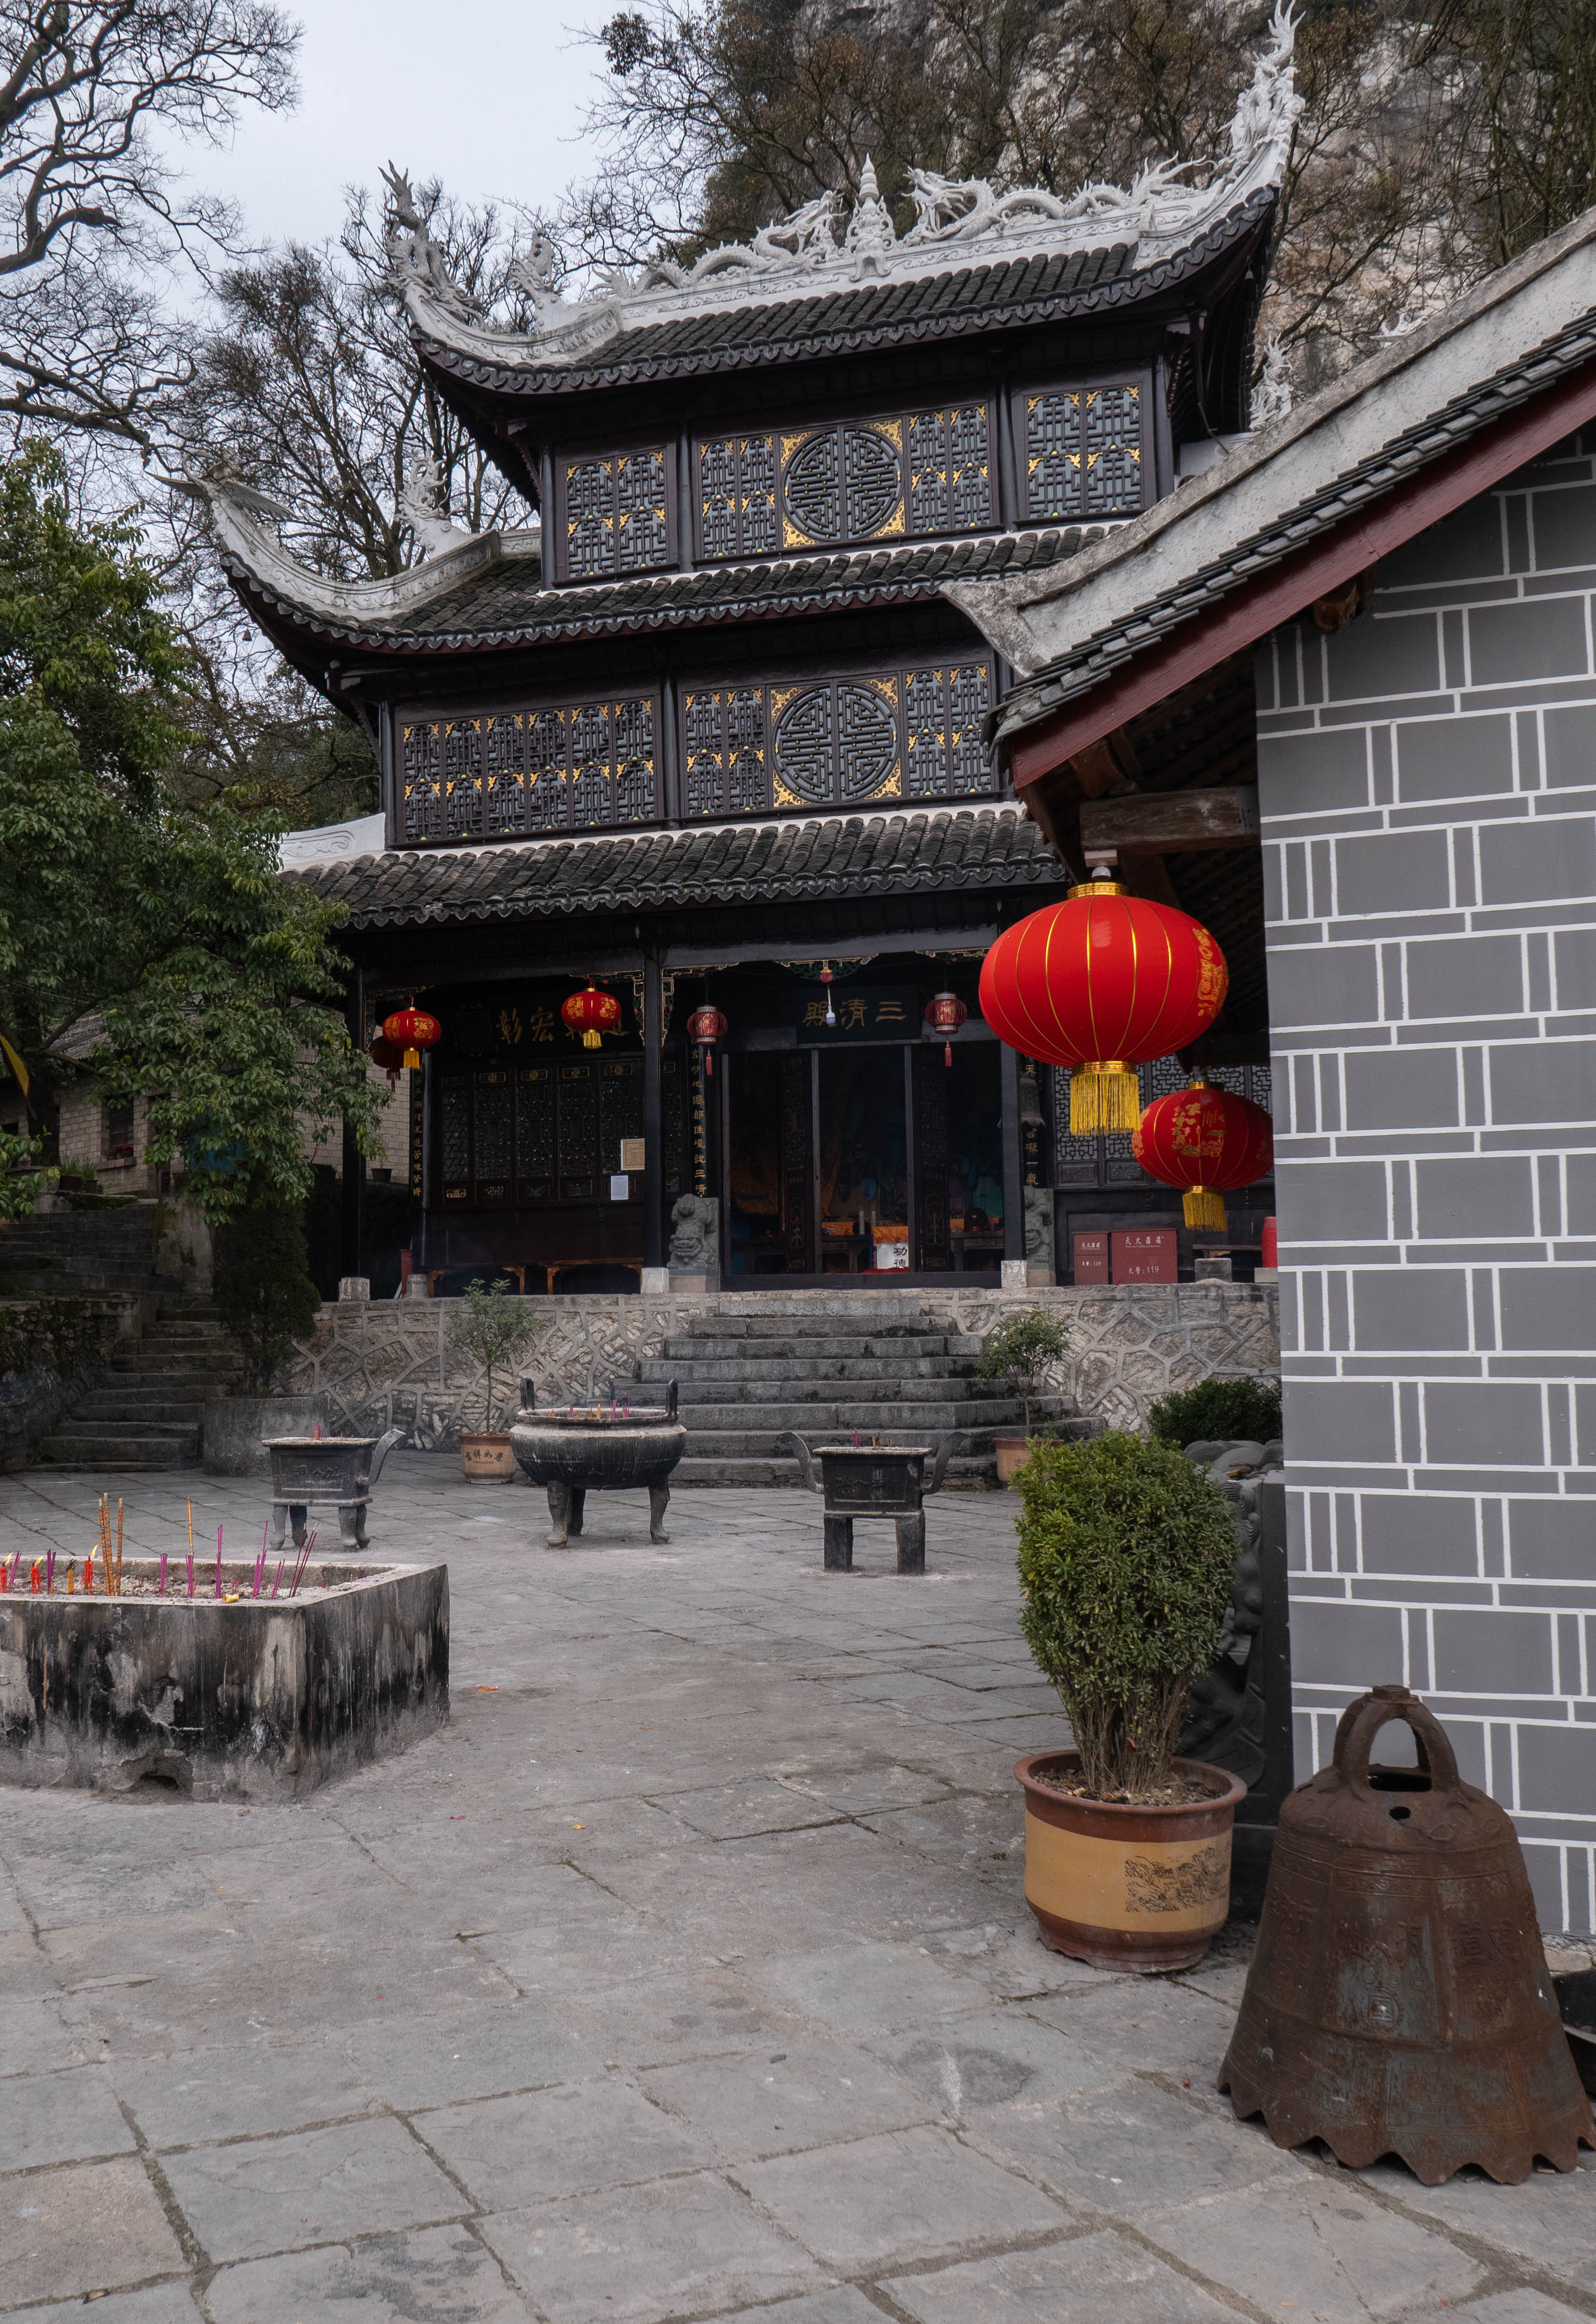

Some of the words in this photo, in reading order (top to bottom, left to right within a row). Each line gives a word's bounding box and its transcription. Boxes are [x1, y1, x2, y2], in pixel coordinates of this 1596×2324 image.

[802, 997, 908, 1030] 三清殿
[893, 1246, 909, 1268] 功德
